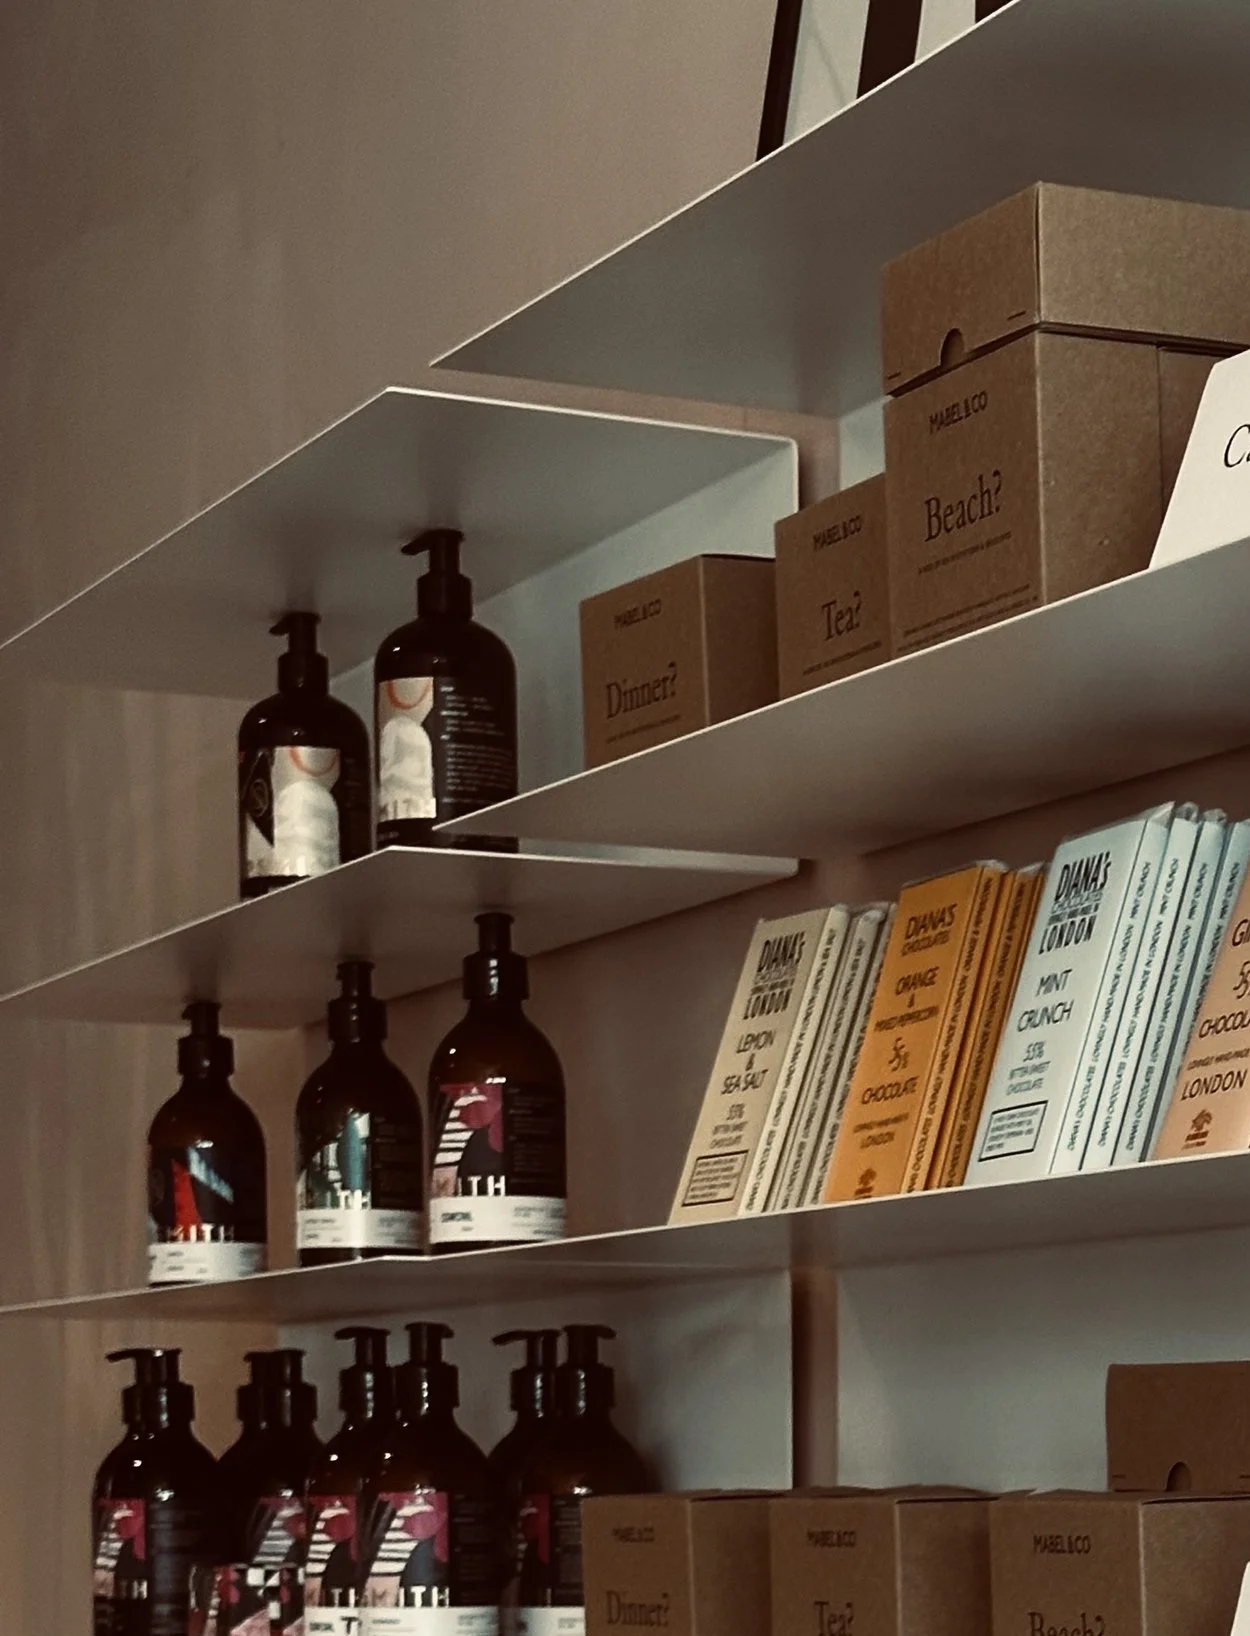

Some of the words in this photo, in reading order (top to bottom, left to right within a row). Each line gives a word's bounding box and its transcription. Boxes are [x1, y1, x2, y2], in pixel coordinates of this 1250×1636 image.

[924, 469, 1003, 542] Beach?
[822, 590, 863, 641] Tea?
[606, 661, 677, 719] Dinner?
[1055, 851, 1112, 902] DIANA'S
[905, 903, 958, 940] DIANA'S
[1038, 914, 1098, 956] LONDON
[757, 931, 806, 974] DIANA'S
[895, 966, 940, 996] ORANGE
[1036, 969, 1073, 997] MINT
[742, 987, 793, 1021] LONDON
[1016, 1000, 1074, 1032] CRUNCH
[735, 1029, 777, 1054] LEMON
[721, 1074, 743, 1096] SEA
[742, 1068, 770, 1093] SALT
[861, 1076, 920, 1105] CHOCOLATE
[1181, 1068, 1248, 1101] LONDON
[1032, 1534, 1091, 1555] MABEL&CO
[606, 1589, 669, 1628] Dinner?
